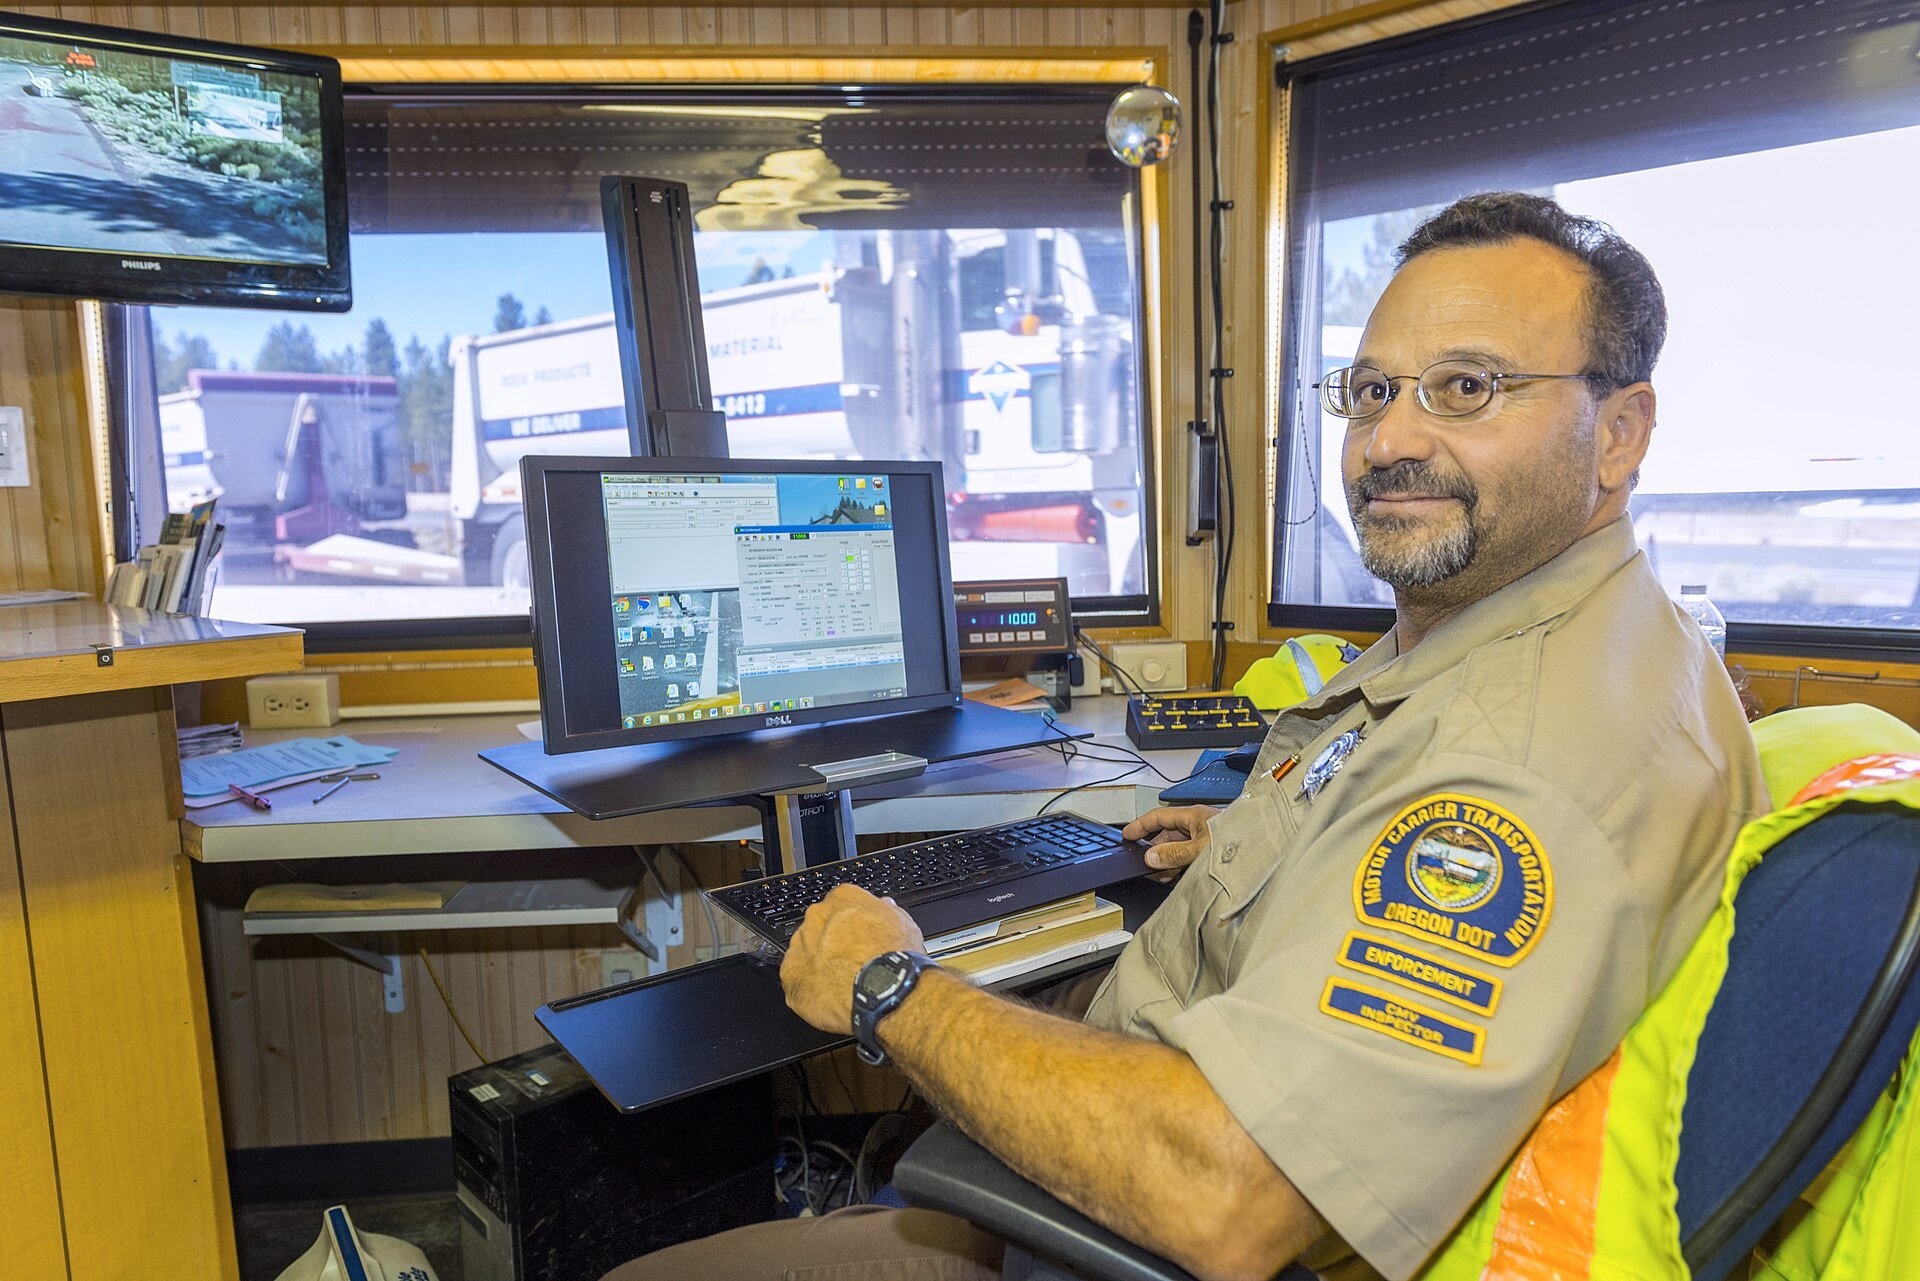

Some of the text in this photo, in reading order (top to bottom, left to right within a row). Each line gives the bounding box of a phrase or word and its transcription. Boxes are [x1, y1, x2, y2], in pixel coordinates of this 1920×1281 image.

[121, 260, 161, 271] PHILIPS
[710, 335, 783, 358] MATERIAL
[502, 362, 592, 388] ROCK PRODUCTS
[511, 413, 581, 437] WE DELIVER
[1000, 612, 1036, 625] 11000
[766, 715, 792, 727] DELL
[1363, 801, 1545, 949] MOTOR CARRIER TRANSPORTATION
[1384, 902, 1496, 951] OREGON DOT
[1364, 946, 1477, 997] ENFORCEMENT
[1384, 1002, 1422, 1022] CMV
[1360, 1005, 1444, 1045] INSPECTOR
